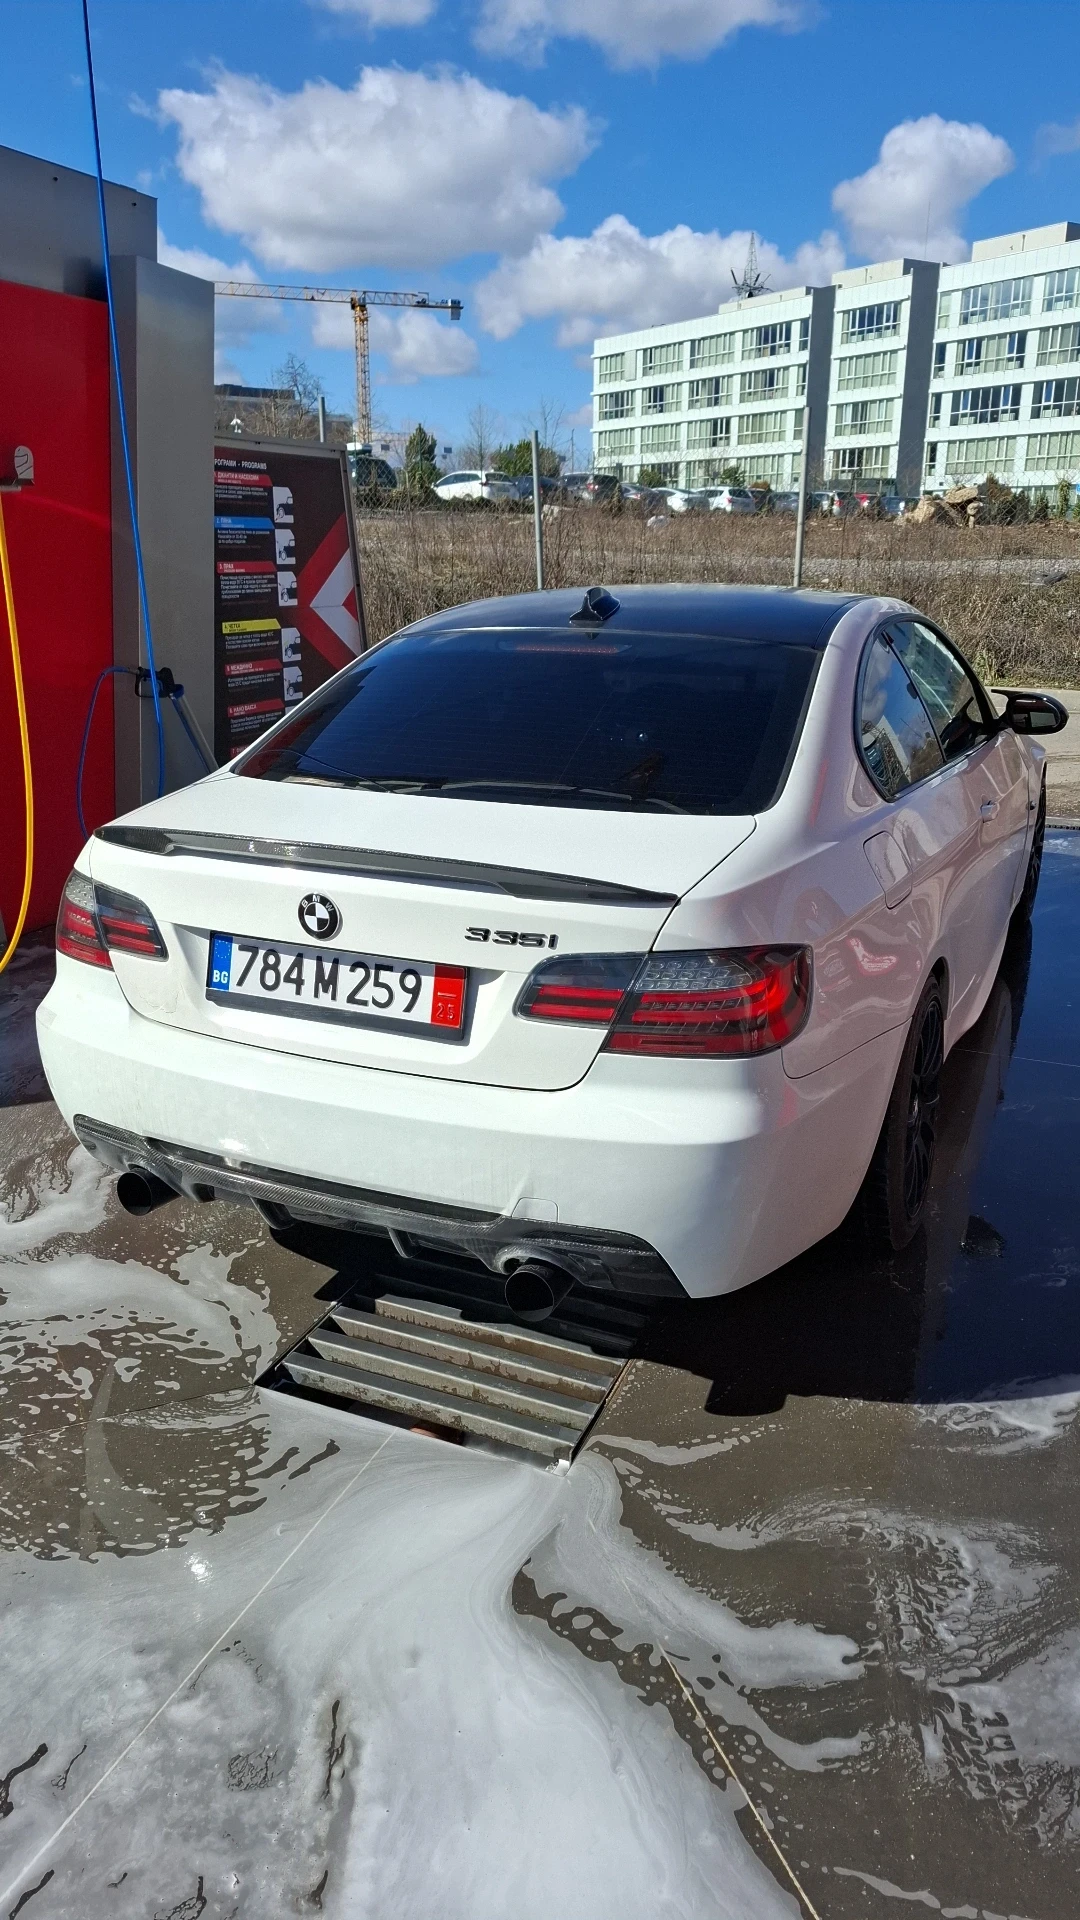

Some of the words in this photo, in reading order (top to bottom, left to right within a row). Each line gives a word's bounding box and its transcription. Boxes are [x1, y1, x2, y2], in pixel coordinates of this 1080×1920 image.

[214, 459, 236, 467] РОГРАМИ
[241, 461, 267, 470] PROGRAMS
[301, 894, 334, 913] BMW
[212, 970, 228, 984] BG
[235, 944, 306, 997] 784
[313, 955, 340, 1001] M
[346, 963, 423, 1013] 259
